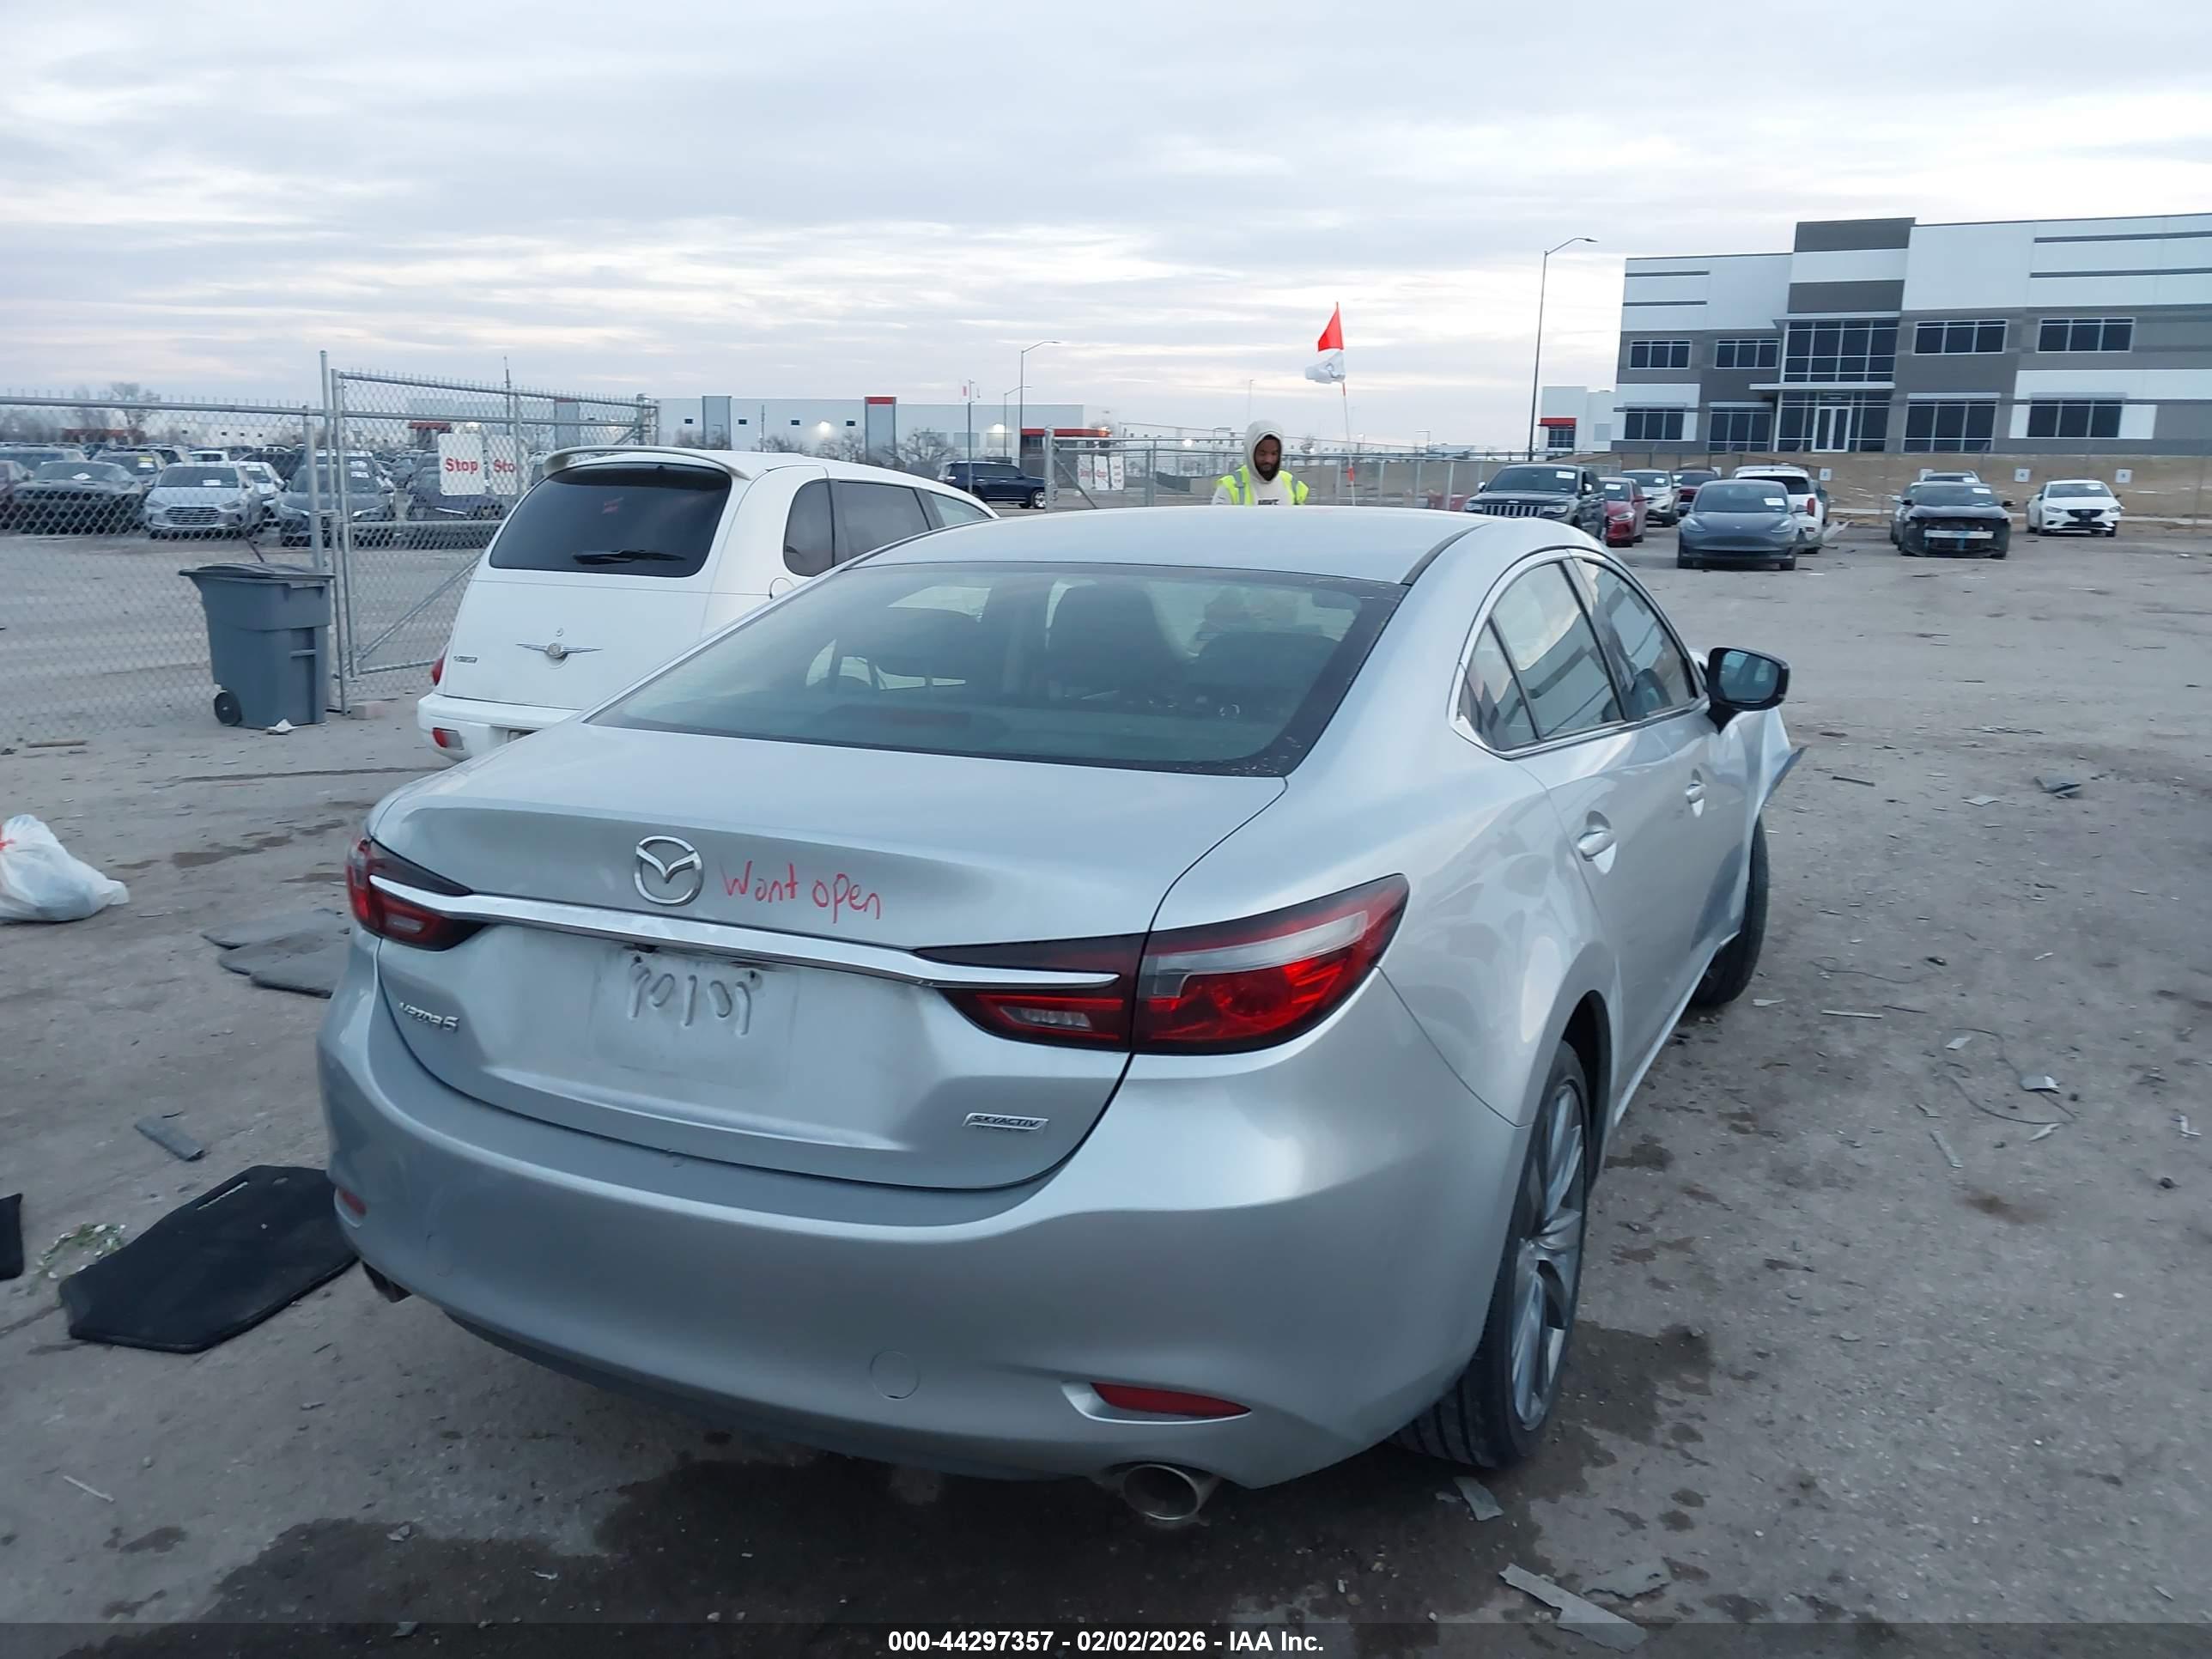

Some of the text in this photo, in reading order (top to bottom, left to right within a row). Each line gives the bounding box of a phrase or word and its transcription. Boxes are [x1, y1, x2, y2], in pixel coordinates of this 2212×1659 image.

[446, 458, 478, 474] Stop
[494, 459, 516, 473] Sto
[812, 873, 881, 924] open
[971, 1115, 1040, 1127] SKYACTIV
